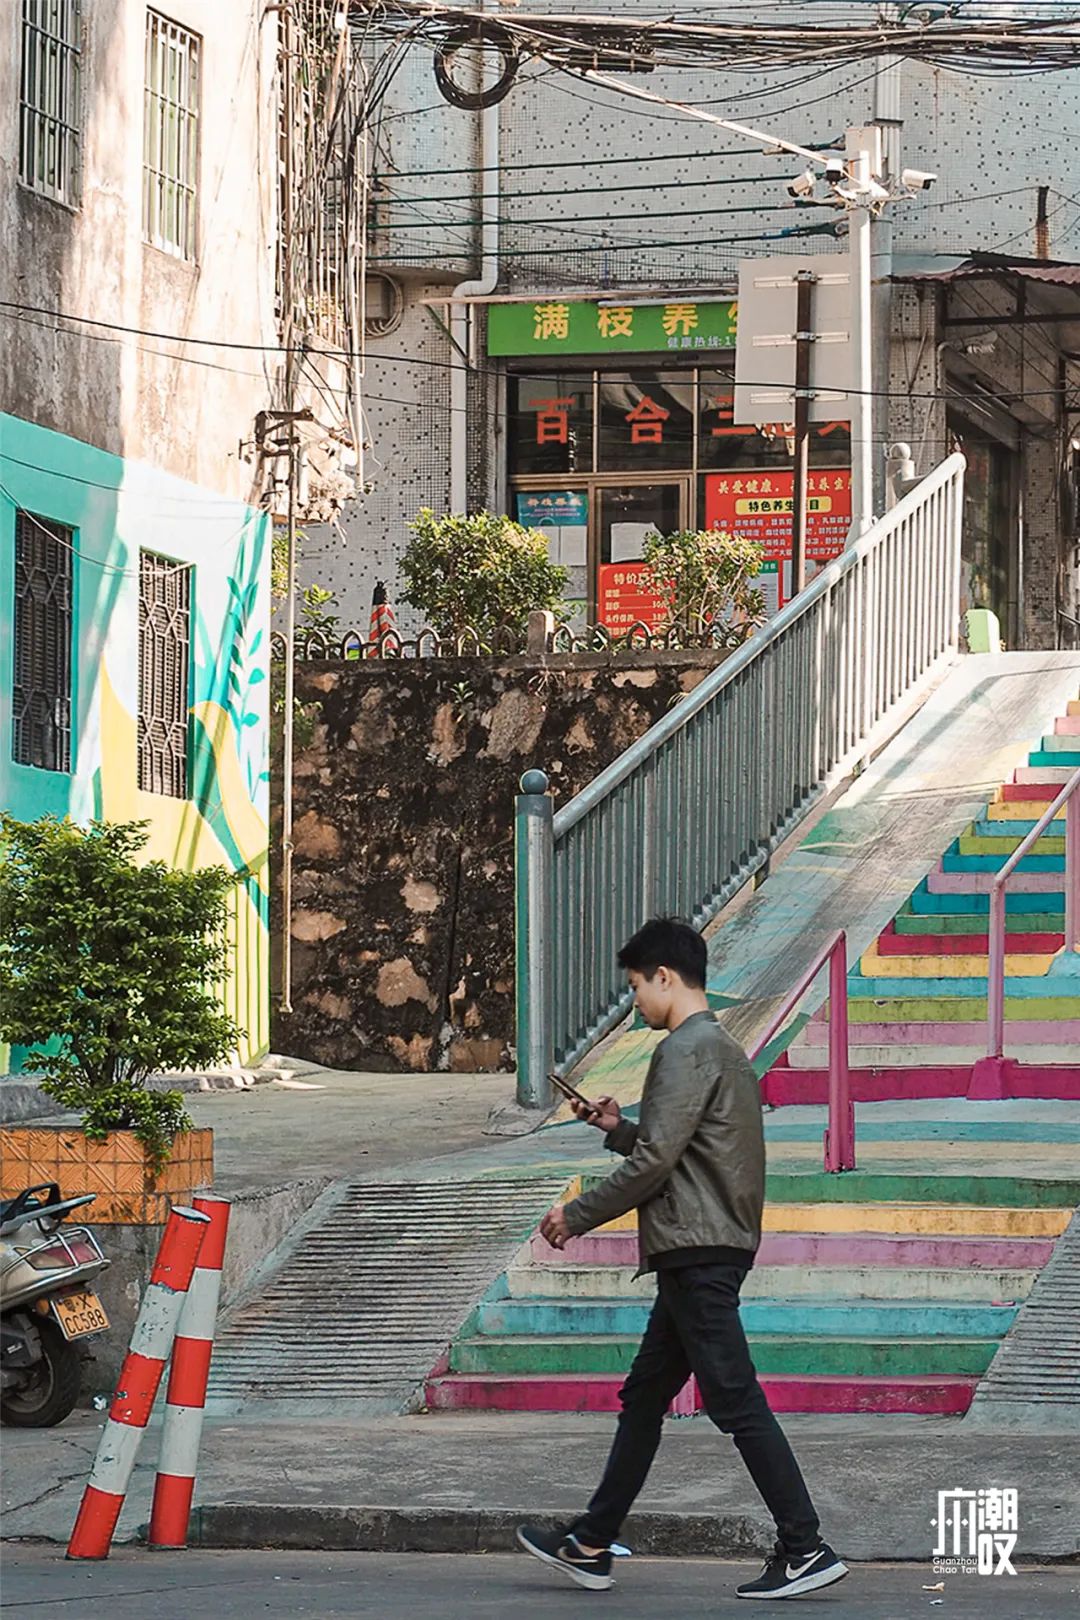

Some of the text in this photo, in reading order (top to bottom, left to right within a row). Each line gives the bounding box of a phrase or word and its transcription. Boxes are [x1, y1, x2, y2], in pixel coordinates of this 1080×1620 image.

[533, 303, 738, 340] 满枝养
[667, 336, 737, 348] 健康热线:1
[749, 499, 819, 513] 特色养生目
[64, 1308, 105, 1334] CC588
